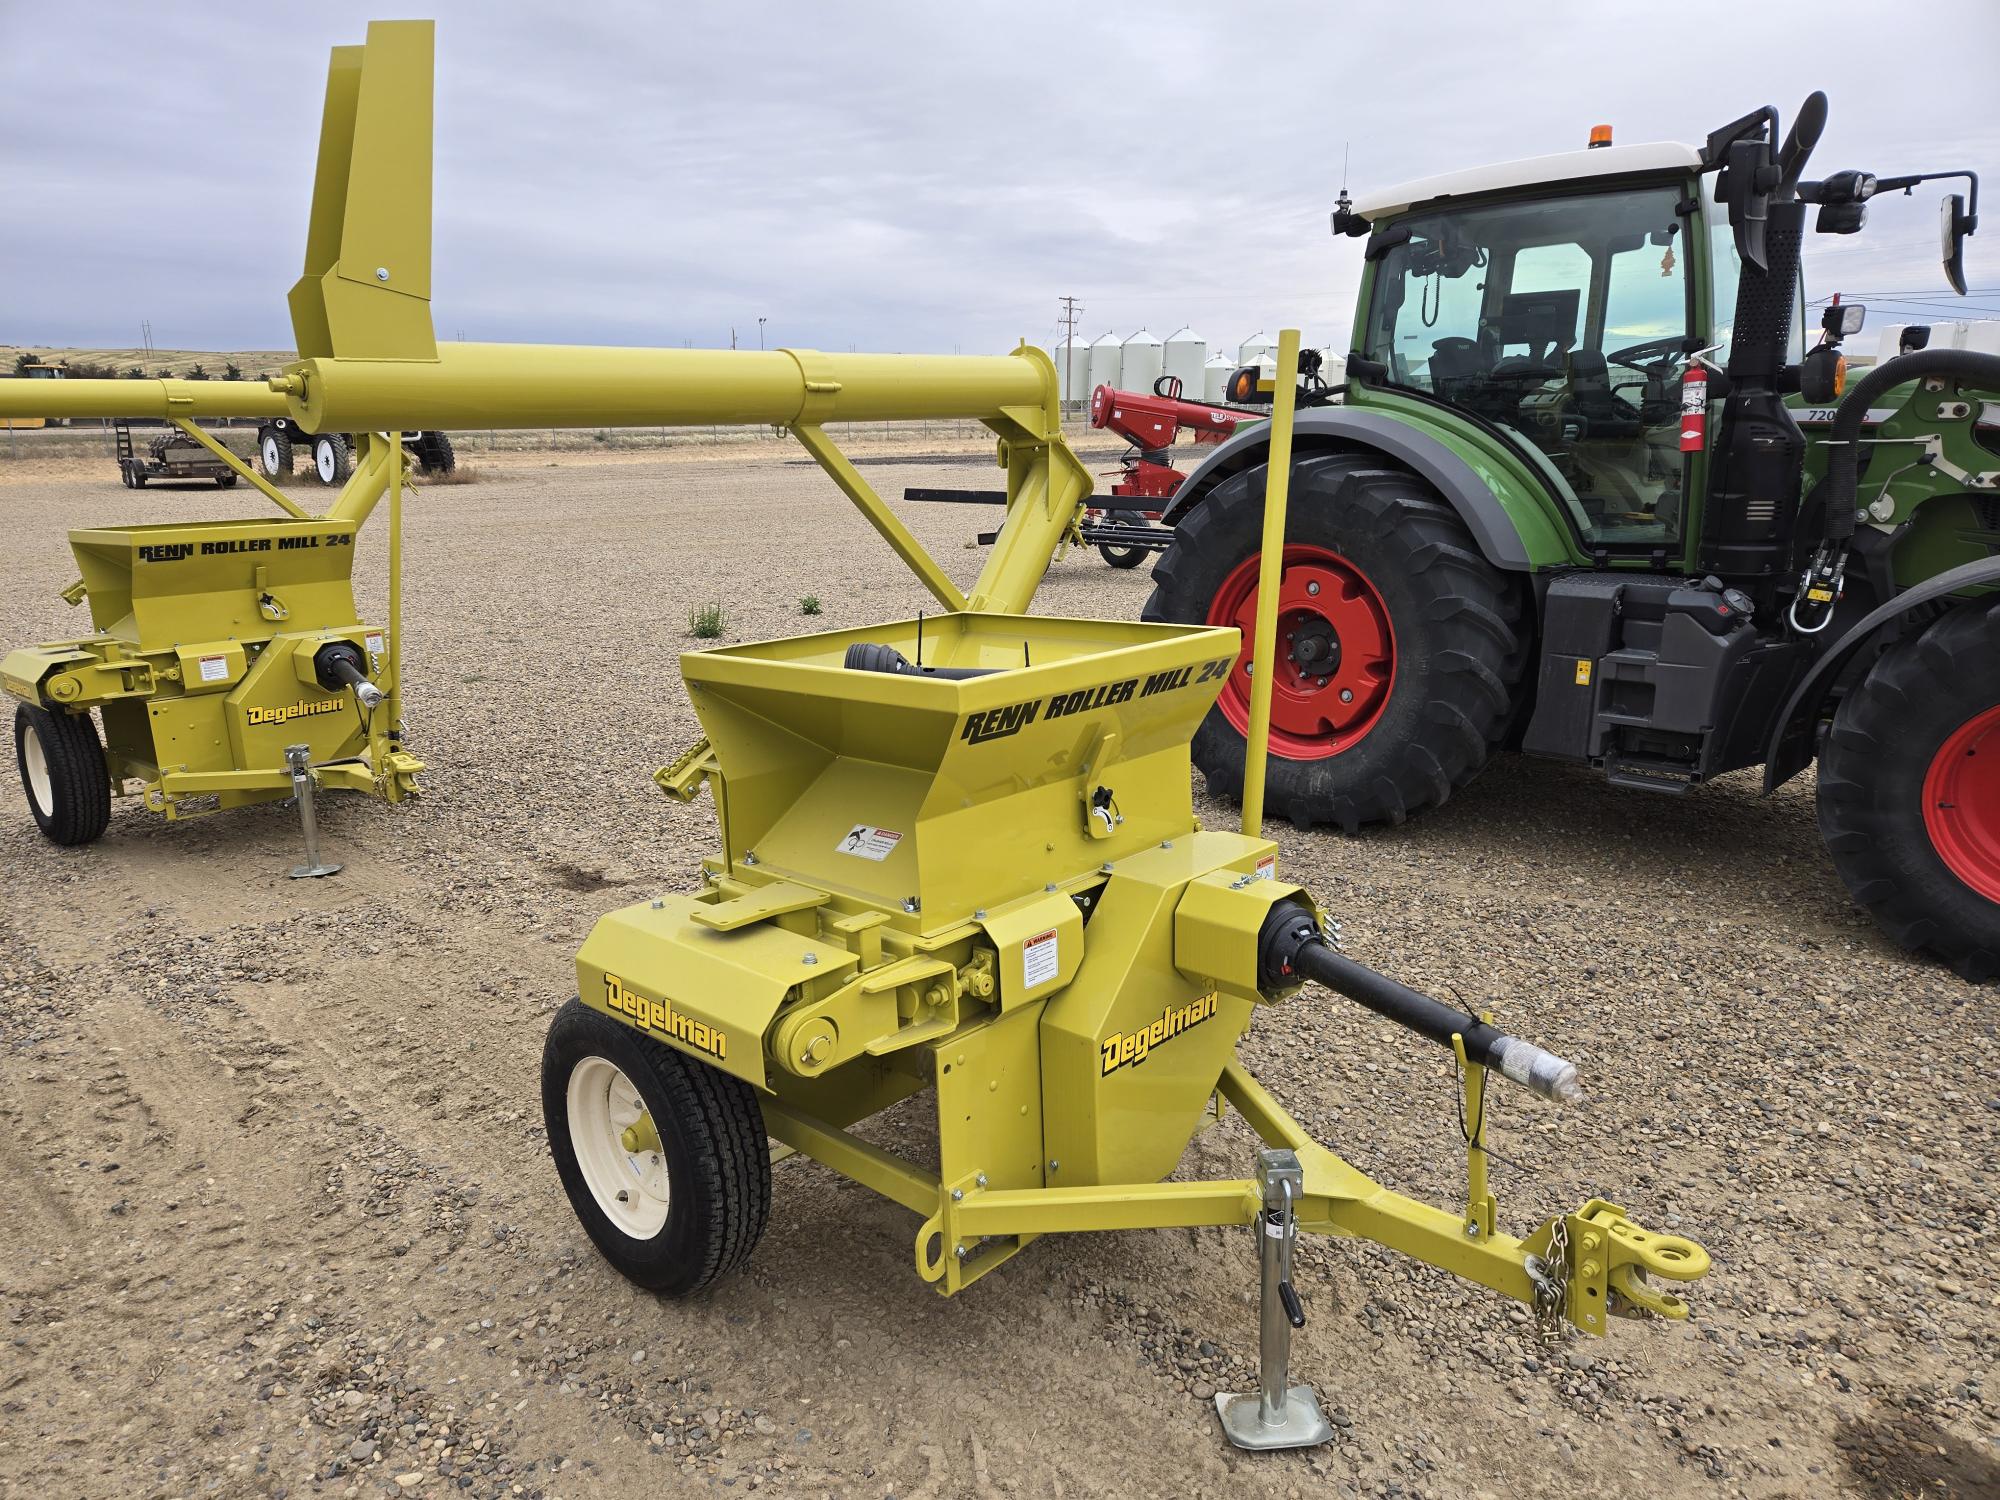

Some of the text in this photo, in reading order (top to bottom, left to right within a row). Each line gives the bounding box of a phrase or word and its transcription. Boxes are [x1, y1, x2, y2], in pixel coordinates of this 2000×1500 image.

[139, 534, 351, 562] RENN ROLLER MILL 24
[246, 698, 344, 726] Degelman
[960, 658, 1231, 745] RENN ROLLER MILL 24
[604, 971, 727, 1061] Degelman
[1101, 990, 1218, 1078] Degelman
